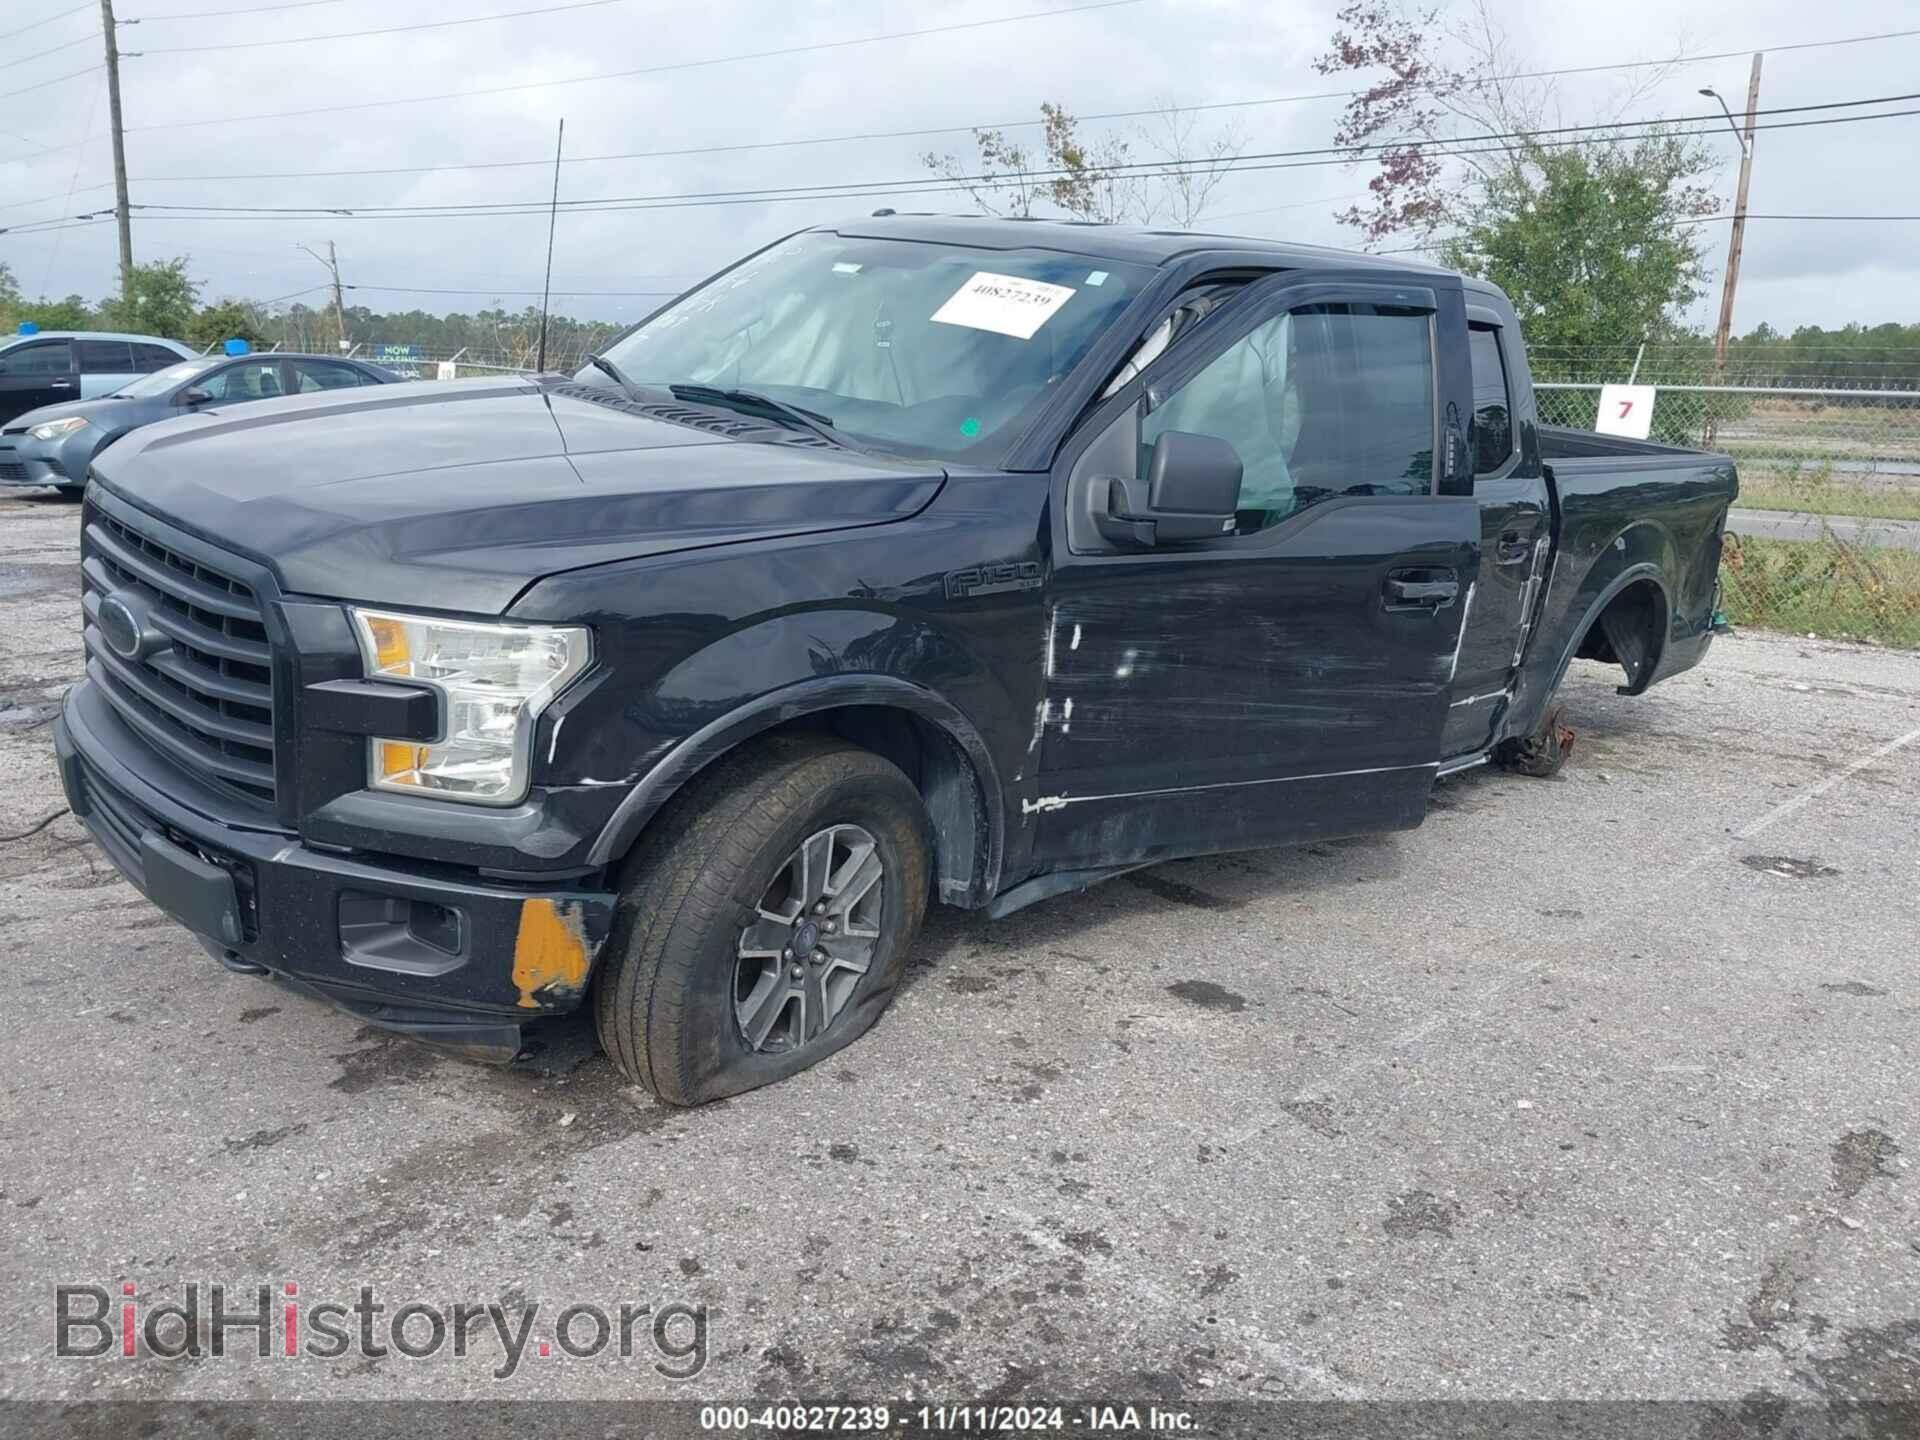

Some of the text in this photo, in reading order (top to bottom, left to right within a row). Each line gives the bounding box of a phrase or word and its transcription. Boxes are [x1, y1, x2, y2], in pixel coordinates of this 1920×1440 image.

[972, 284, 1052, 305] 40827239
[384, 345, 410, 355] NOW
[1619, 401, 1633, 419] 7
